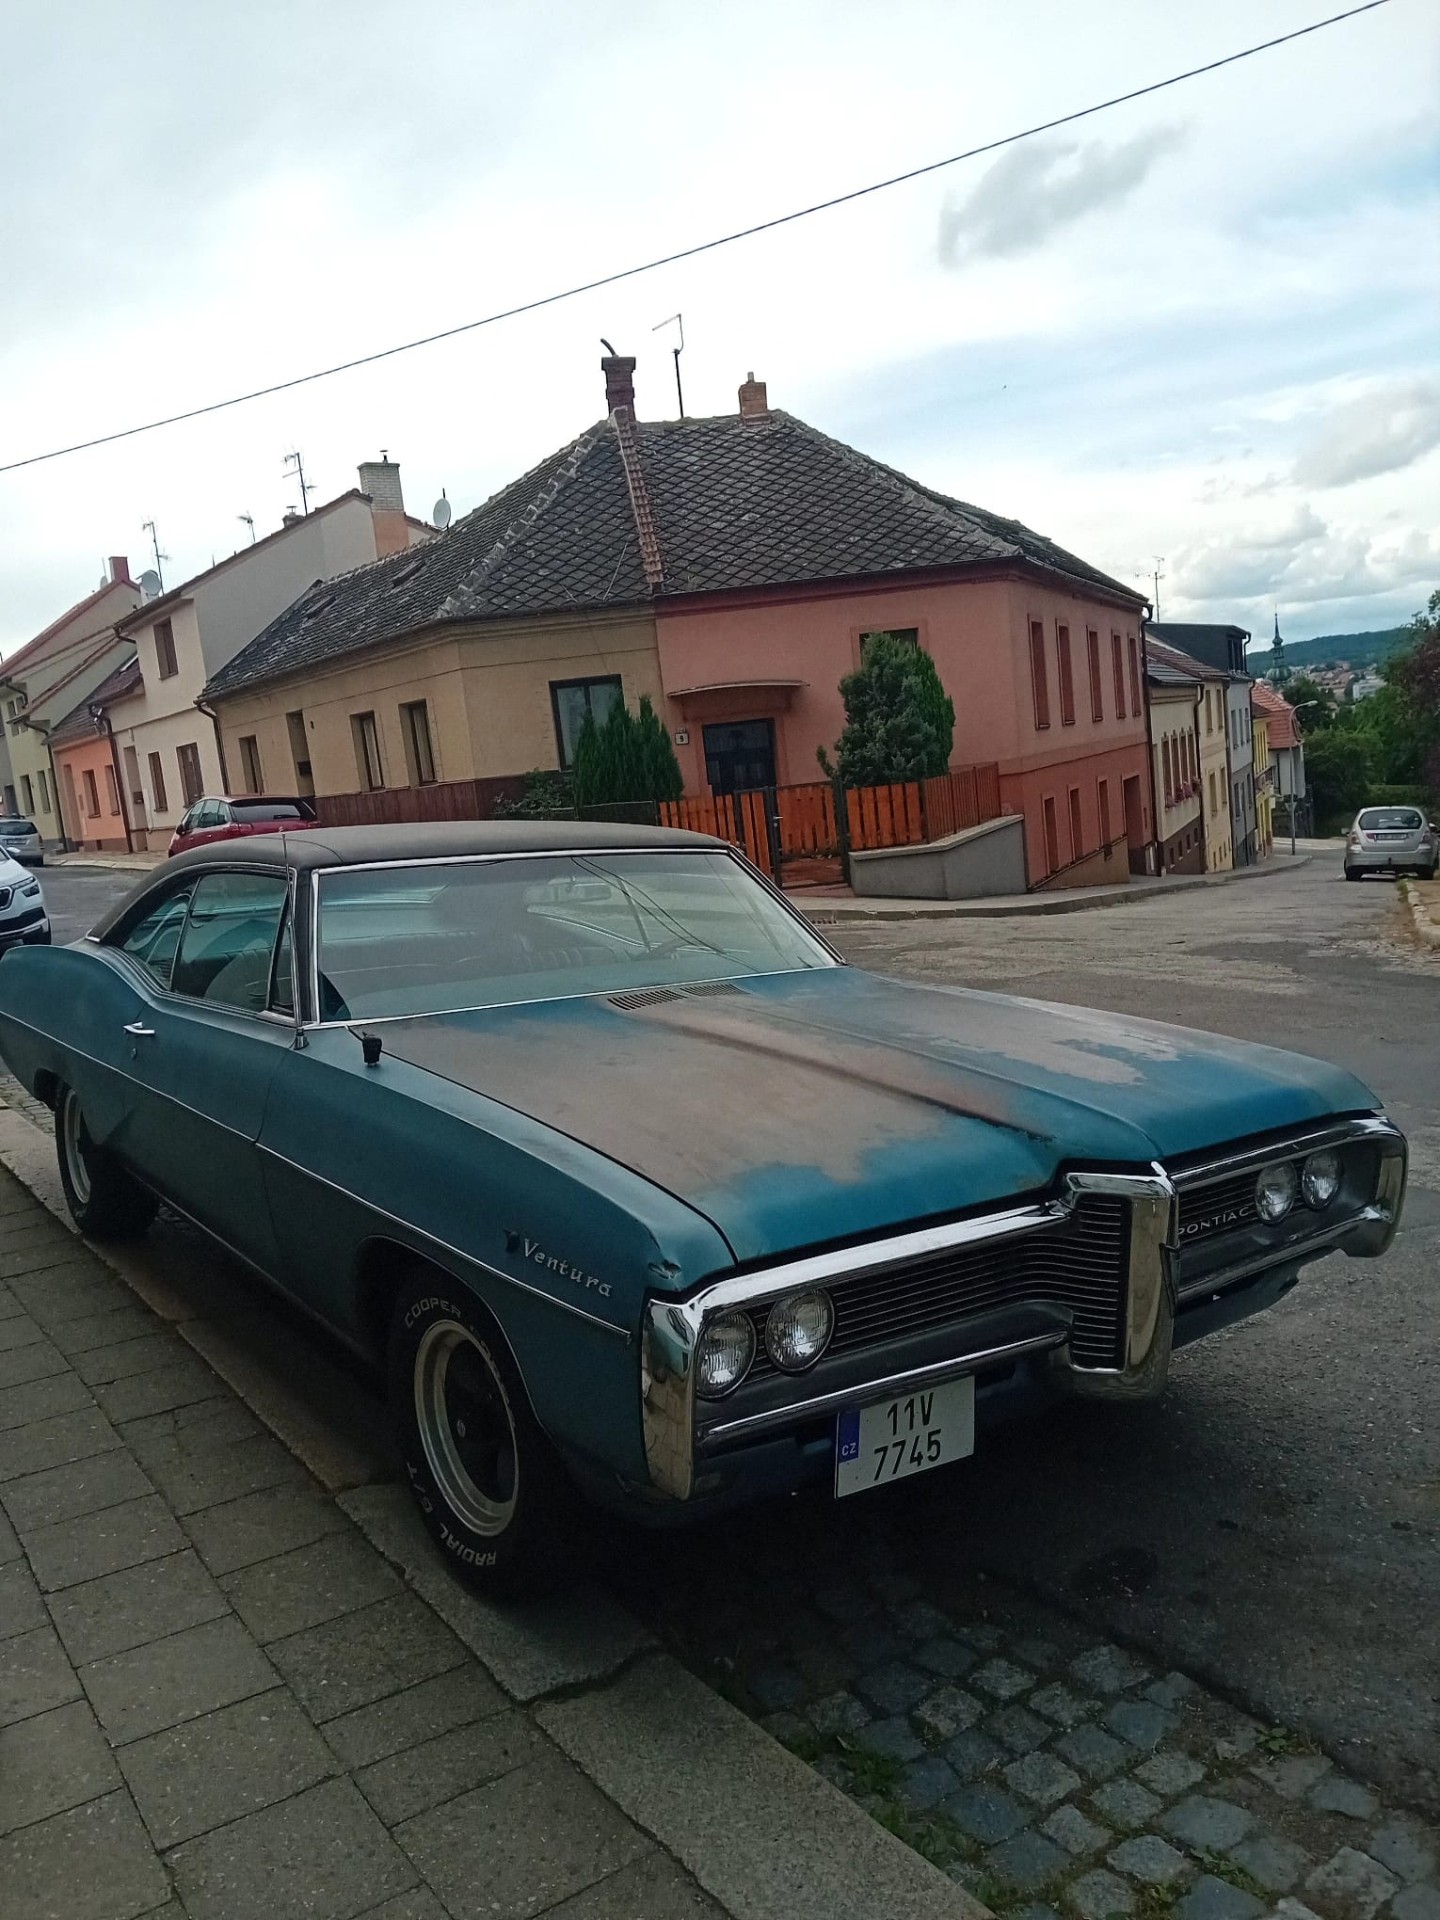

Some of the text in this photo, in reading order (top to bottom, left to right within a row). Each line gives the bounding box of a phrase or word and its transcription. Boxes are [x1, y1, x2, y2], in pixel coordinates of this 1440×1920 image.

[523, 1238, 612, 1297] Ventura
[404, 1297, 461, 1329] COOPER
[887, 1392, 934, 1436] 11V
[841, 1443, 856, 1456] CZ
[874, 1429, 941, 1481] 7745
[440, 1522, 497, 1567] RADIAL
